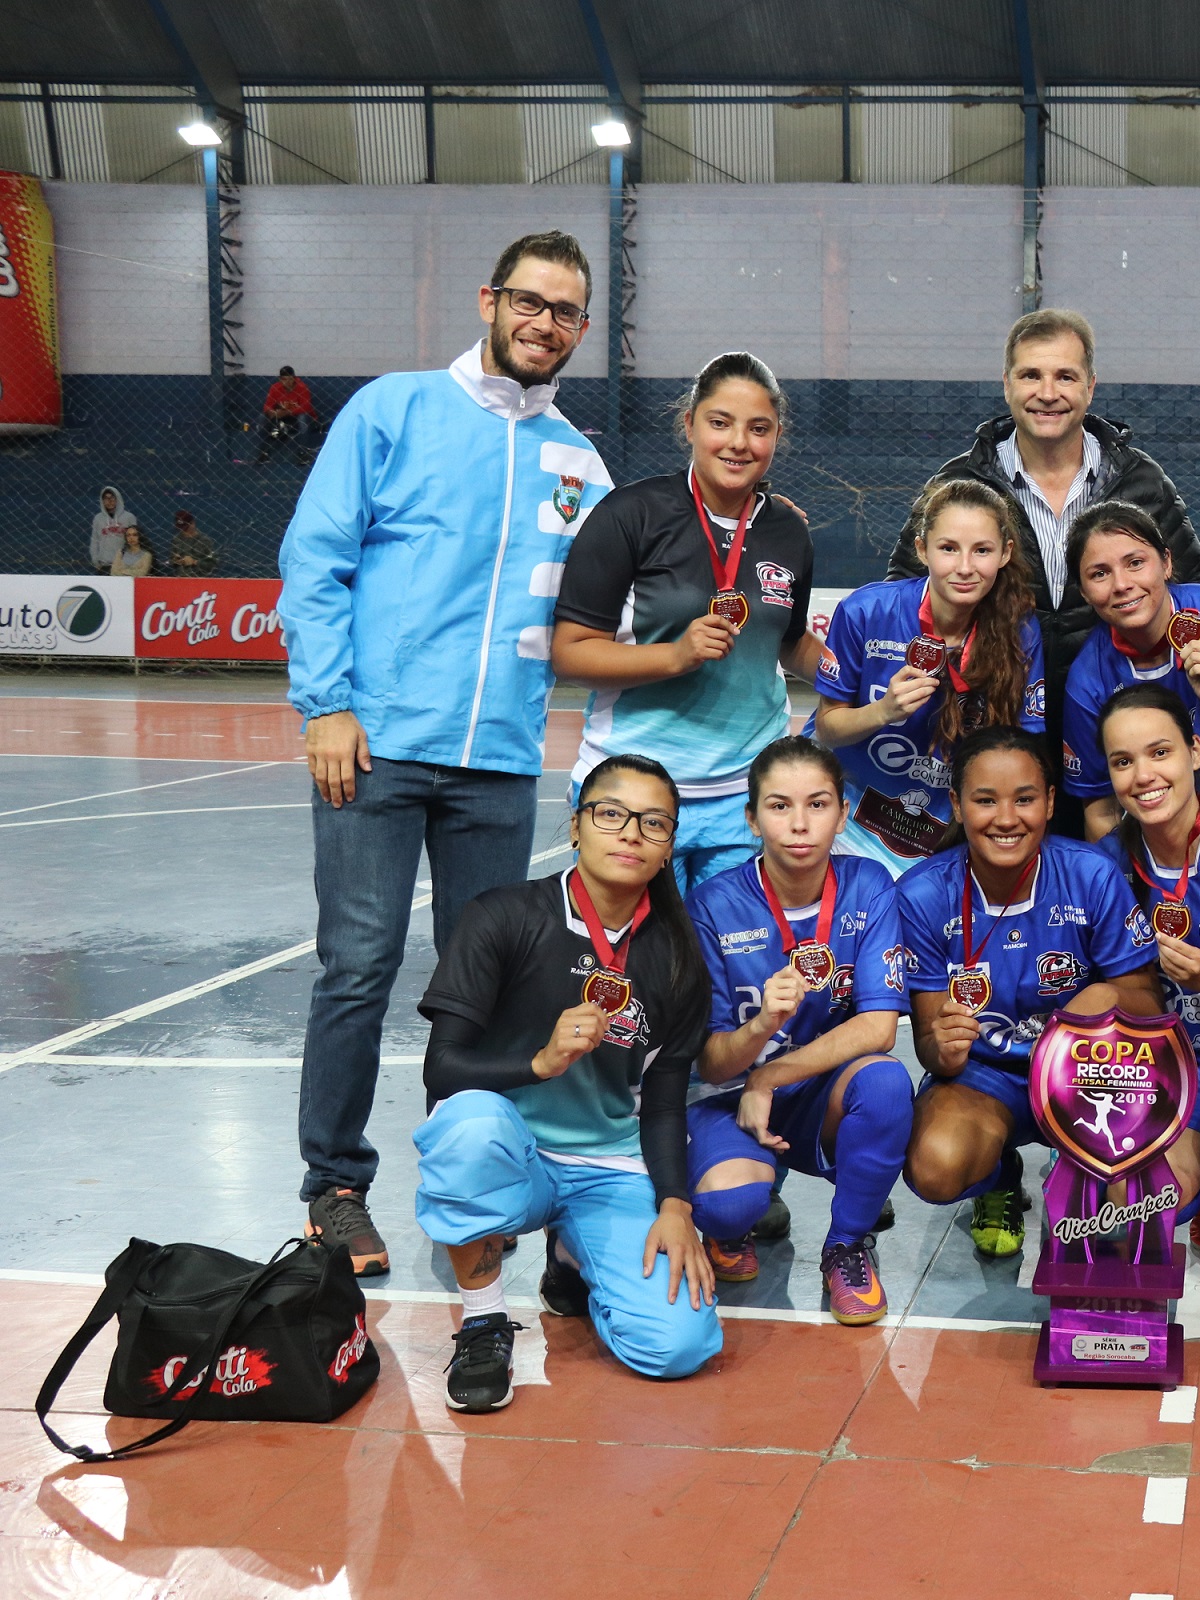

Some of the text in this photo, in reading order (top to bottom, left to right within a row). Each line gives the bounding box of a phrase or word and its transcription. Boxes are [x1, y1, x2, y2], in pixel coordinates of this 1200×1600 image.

[142, 591, 217, 641] Conti
[188, 624, 220, 645] Cola
[911, 768, 951, 786] CONTÁ
[1041, 969, 1078, 983] FUTSAL
[1070, 1039, 1156, 1065] COPA
[1077, 1063, 1149, 1079] RECORD
[1115, 1091, 1157, 1104] 2019
[1094, 1342, 1126, 1351] PRATA
[222, 1376, 257, 1396] Cola
